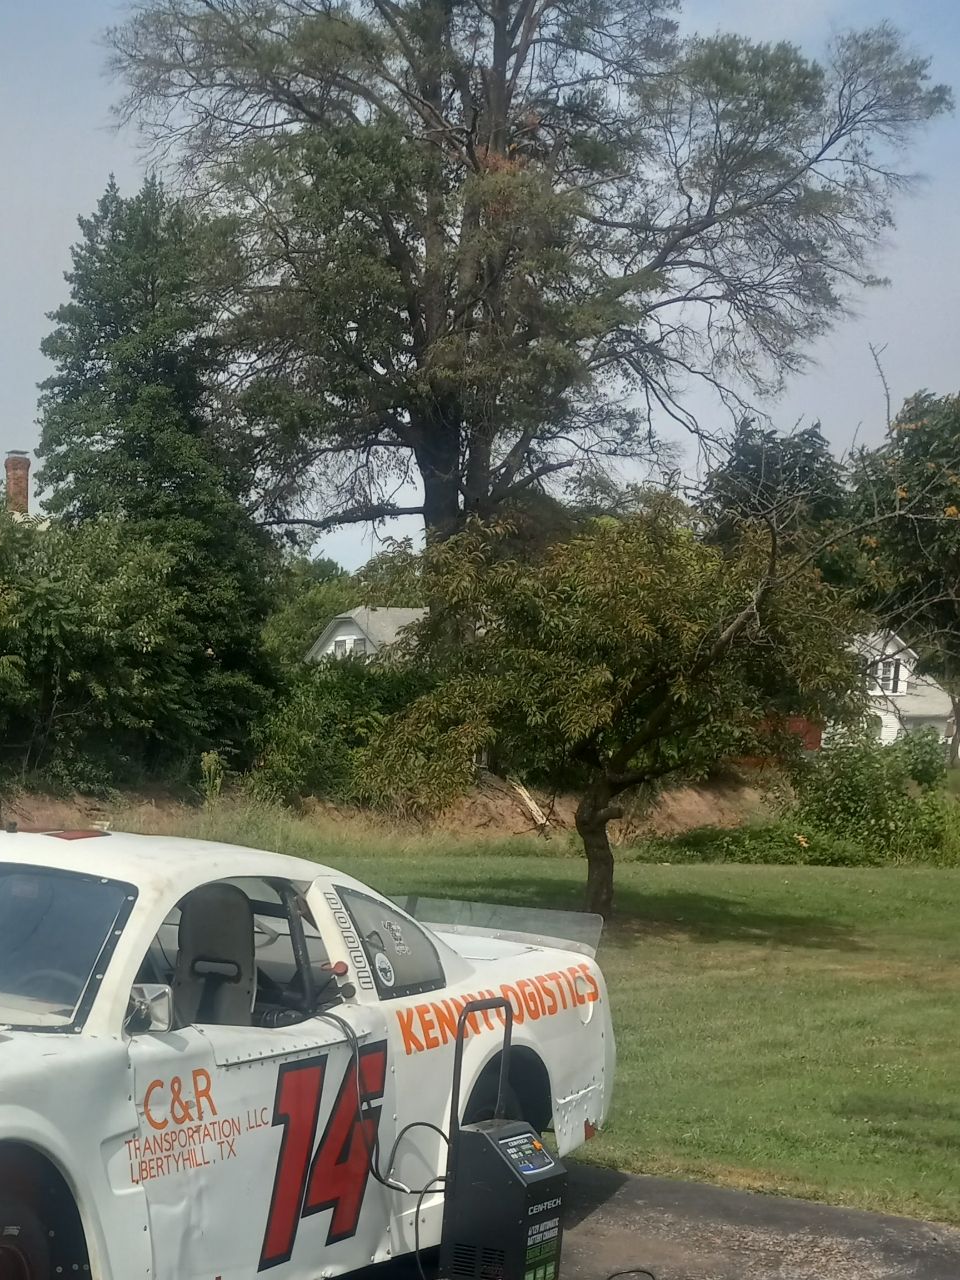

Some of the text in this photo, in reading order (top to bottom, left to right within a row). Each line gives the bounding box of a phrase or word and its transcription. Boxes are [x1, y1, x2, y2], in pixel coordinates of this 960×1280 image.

[143, 1068, 218, 1130] C&R
[125, 1116, 241, 1161] TRANSPORTATION
[217, 1138, 237, 1162] TX
[257, 1039, 388, 1273] 14
[528, 1197, 562, 1216] CEN-TECH
